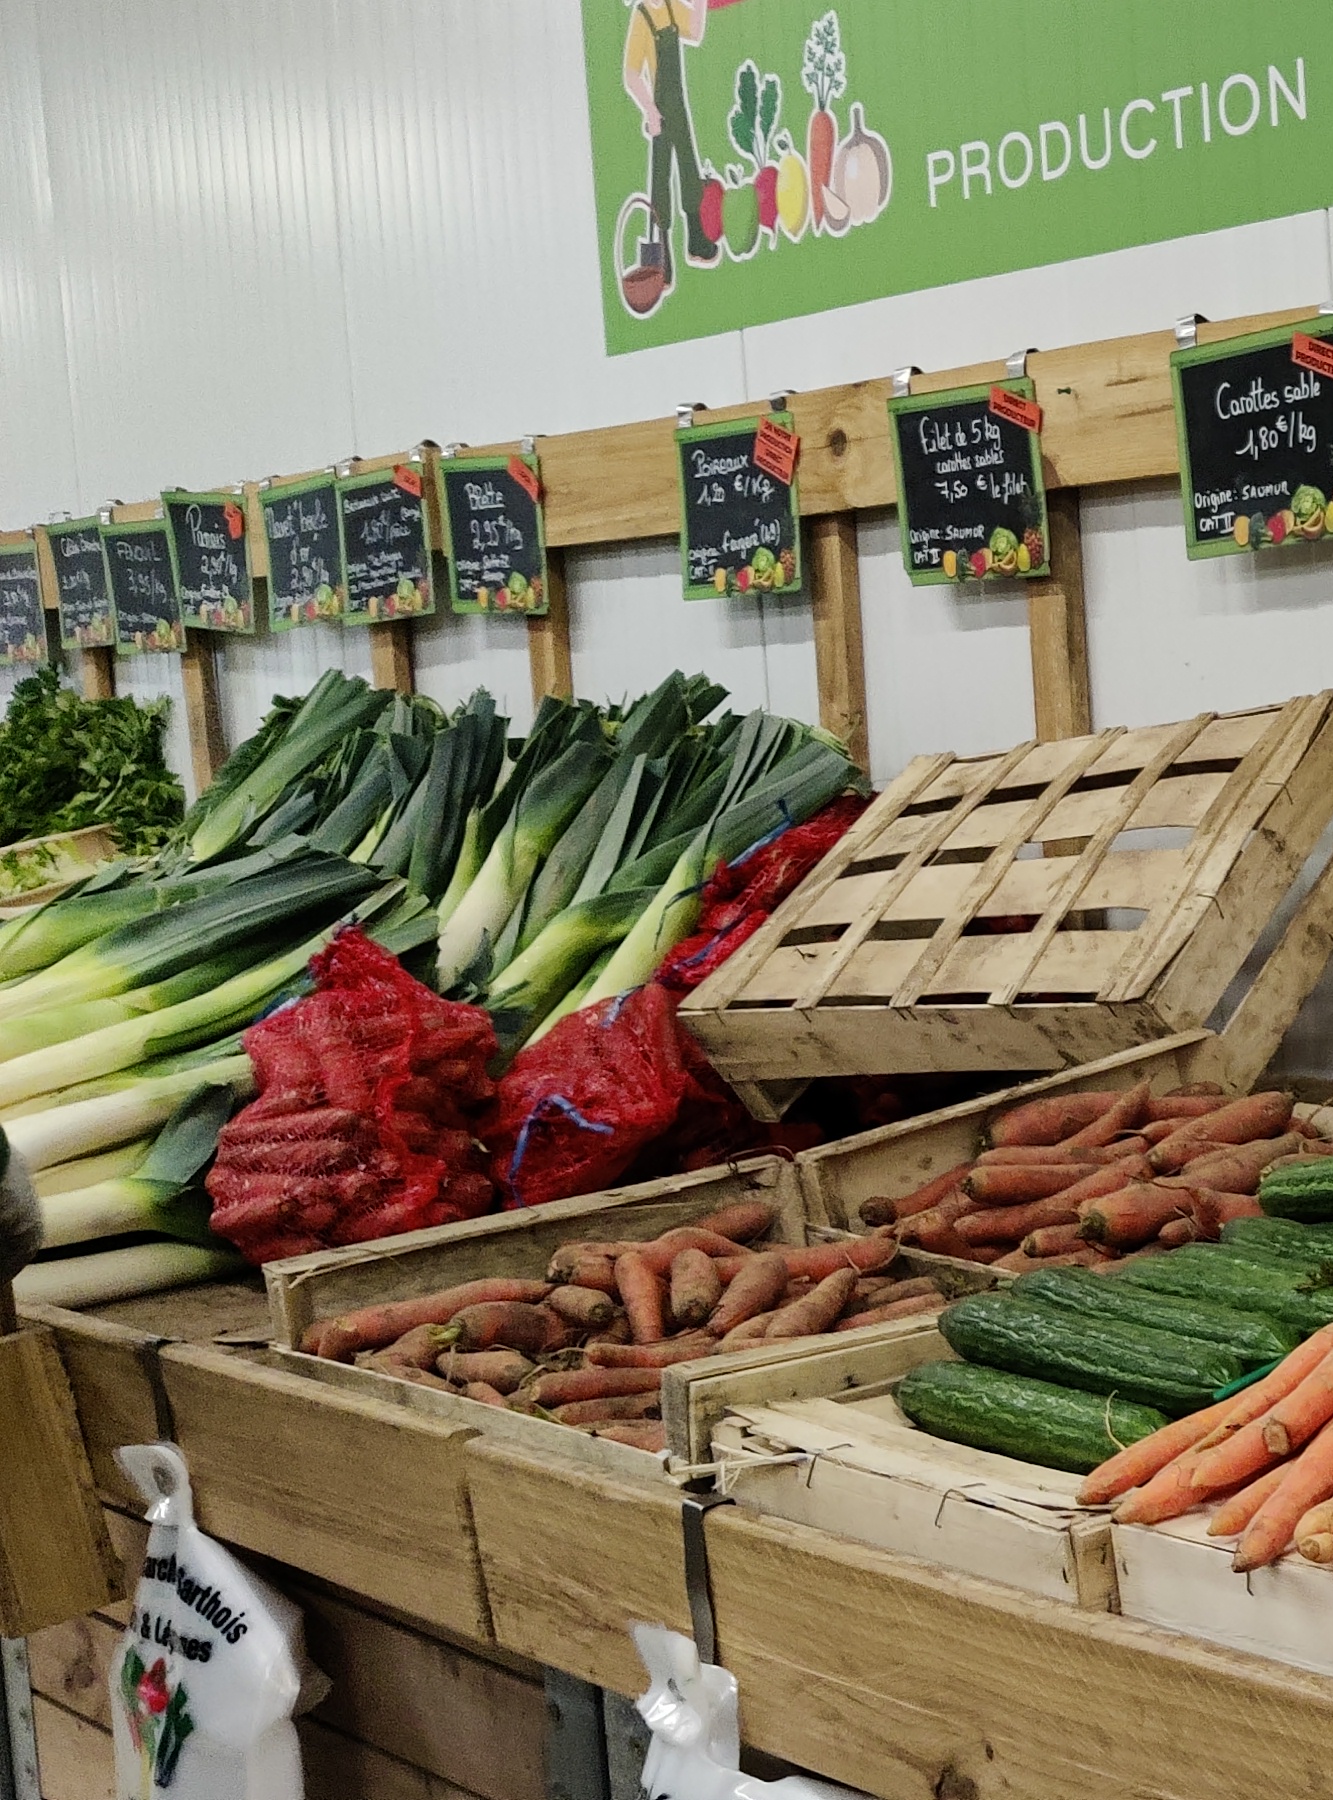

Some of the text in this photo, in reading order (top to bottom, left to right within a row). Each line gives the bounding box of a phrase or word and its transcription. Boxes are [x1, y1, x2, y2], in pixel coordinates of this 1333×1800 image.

[925, 57, 1308, 208] PRODUCTION
[1216, 370, 1321, 420] Carottes sable
[955, 422, 967, 447] de
[971, 419, 982, 444] 5
[984, 415, 1001, 450] kg
